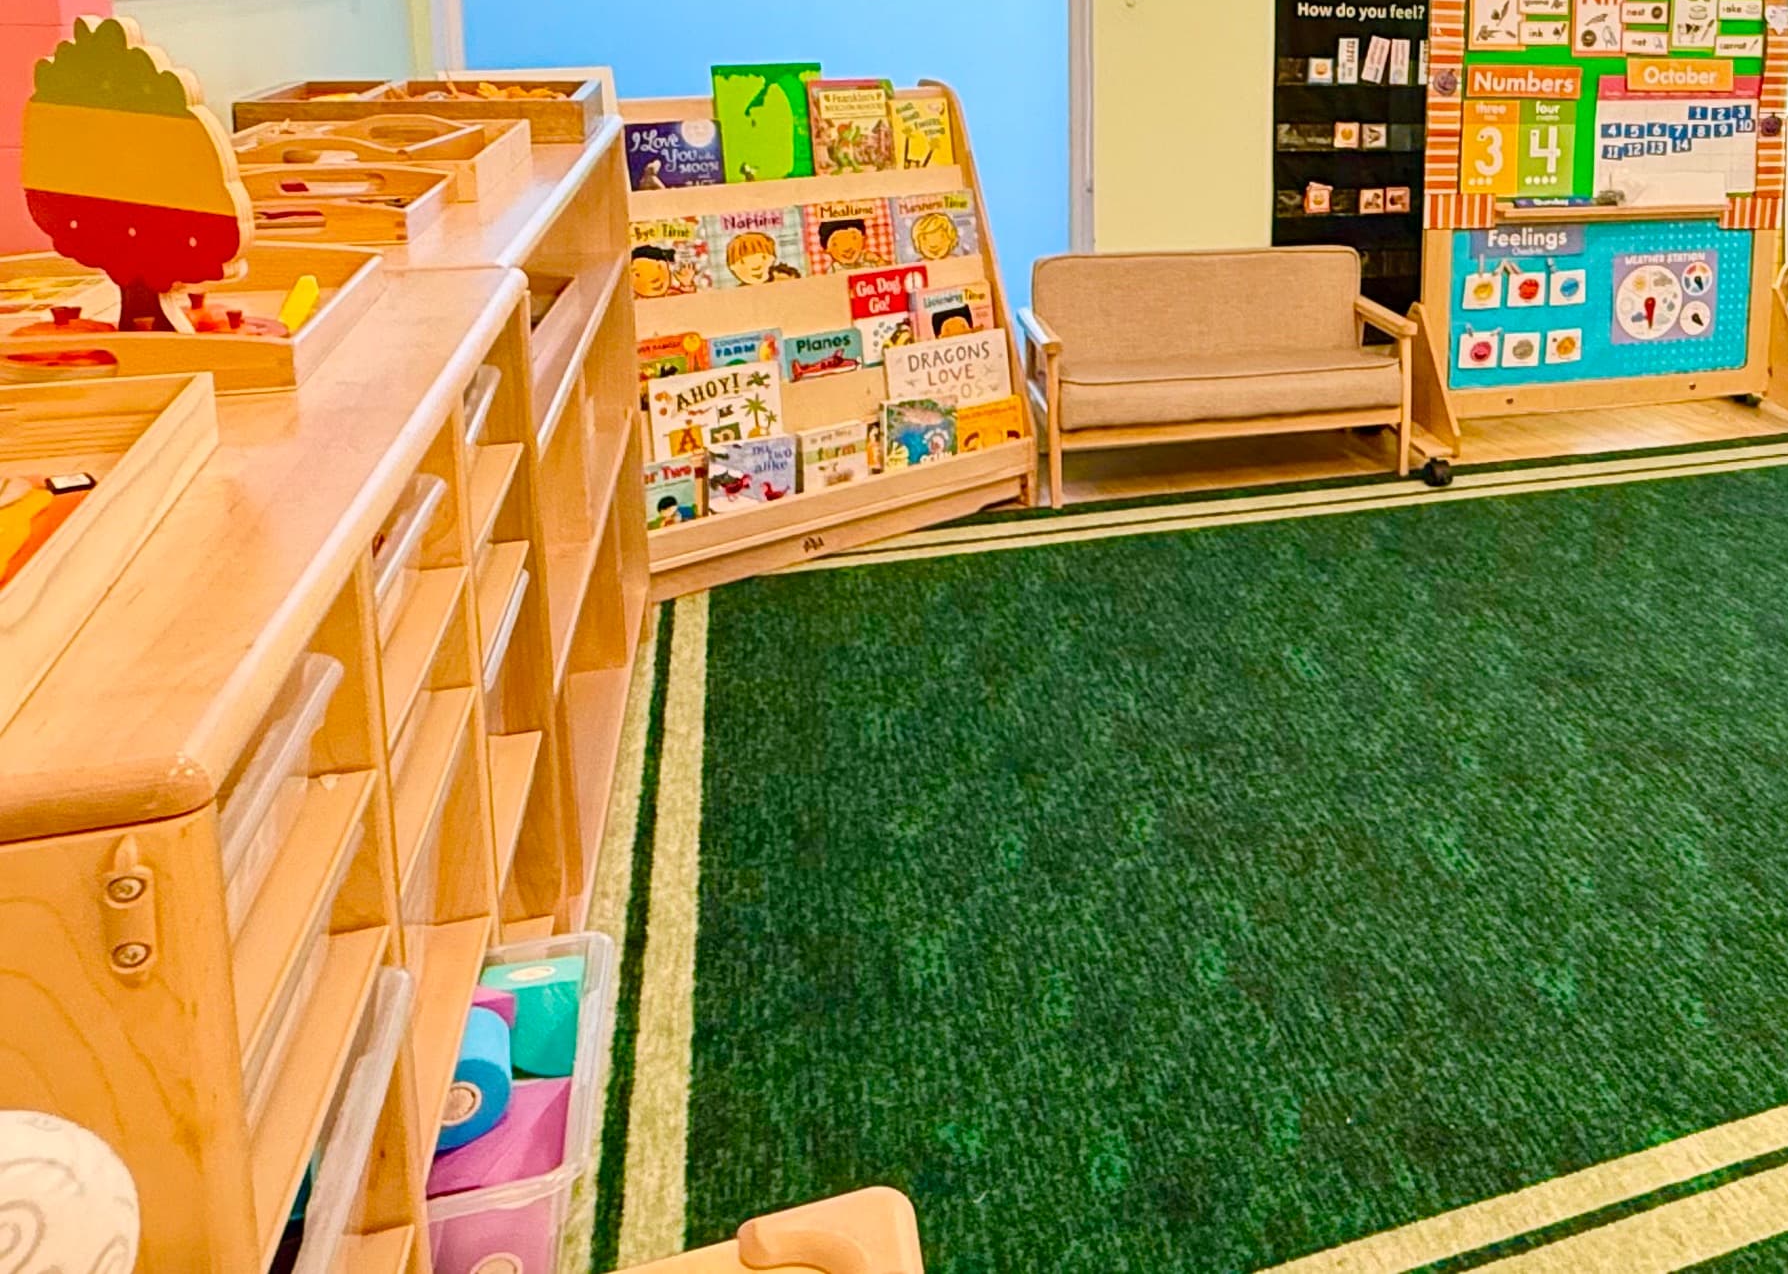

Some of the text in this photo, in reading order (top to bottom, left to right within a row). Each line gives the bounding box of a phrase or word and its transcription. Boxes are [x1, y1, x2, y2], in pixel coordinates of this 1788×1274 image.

[1297, 2, 1425, 22] How do you feel?
[1528, 29, 1544, 38] ink
[1473, 69, 1574, 93] Numbers
[1643, 65, 1718, 85] October
[1476, 101, 1507, 114] three
[1535, 100, 1560, 115] four
[1695, 106, 1747, 120] 1 2 3
[1607, 120, 1753, 138] 4 5 6 7 8 9 10
[640, 129, 681, 154] Love
[1474, 126, 1504, 176] 3
[1529, 124, 1561, 174] 4
[1607, 137, 1690, 158] 11 12 13 14
[661, 148, 698, 173] You
[944, 195, 968, 209] Time
[820, 205, 874, 219] Mealtime
[662, 223, 690, 239] Time
[723, 215, 783, 230] Naptime
[1488, 227, 1568, 250] Feelings
[964, 288, 987, 301] Time
[868, 295, 891, 314] Go!
[715, 343, 756, 358] FARM
[796, 334, 850, 354] Planes
[907, 341, 990, 373] DRAGONS
[928, 364, 975, 386] LOVE
[676, 373, 740, 413] AHOY!
[679, 428, 700, 453] A
[769, 445, 793, 461] two
[754, 459, 789, 474] alike
